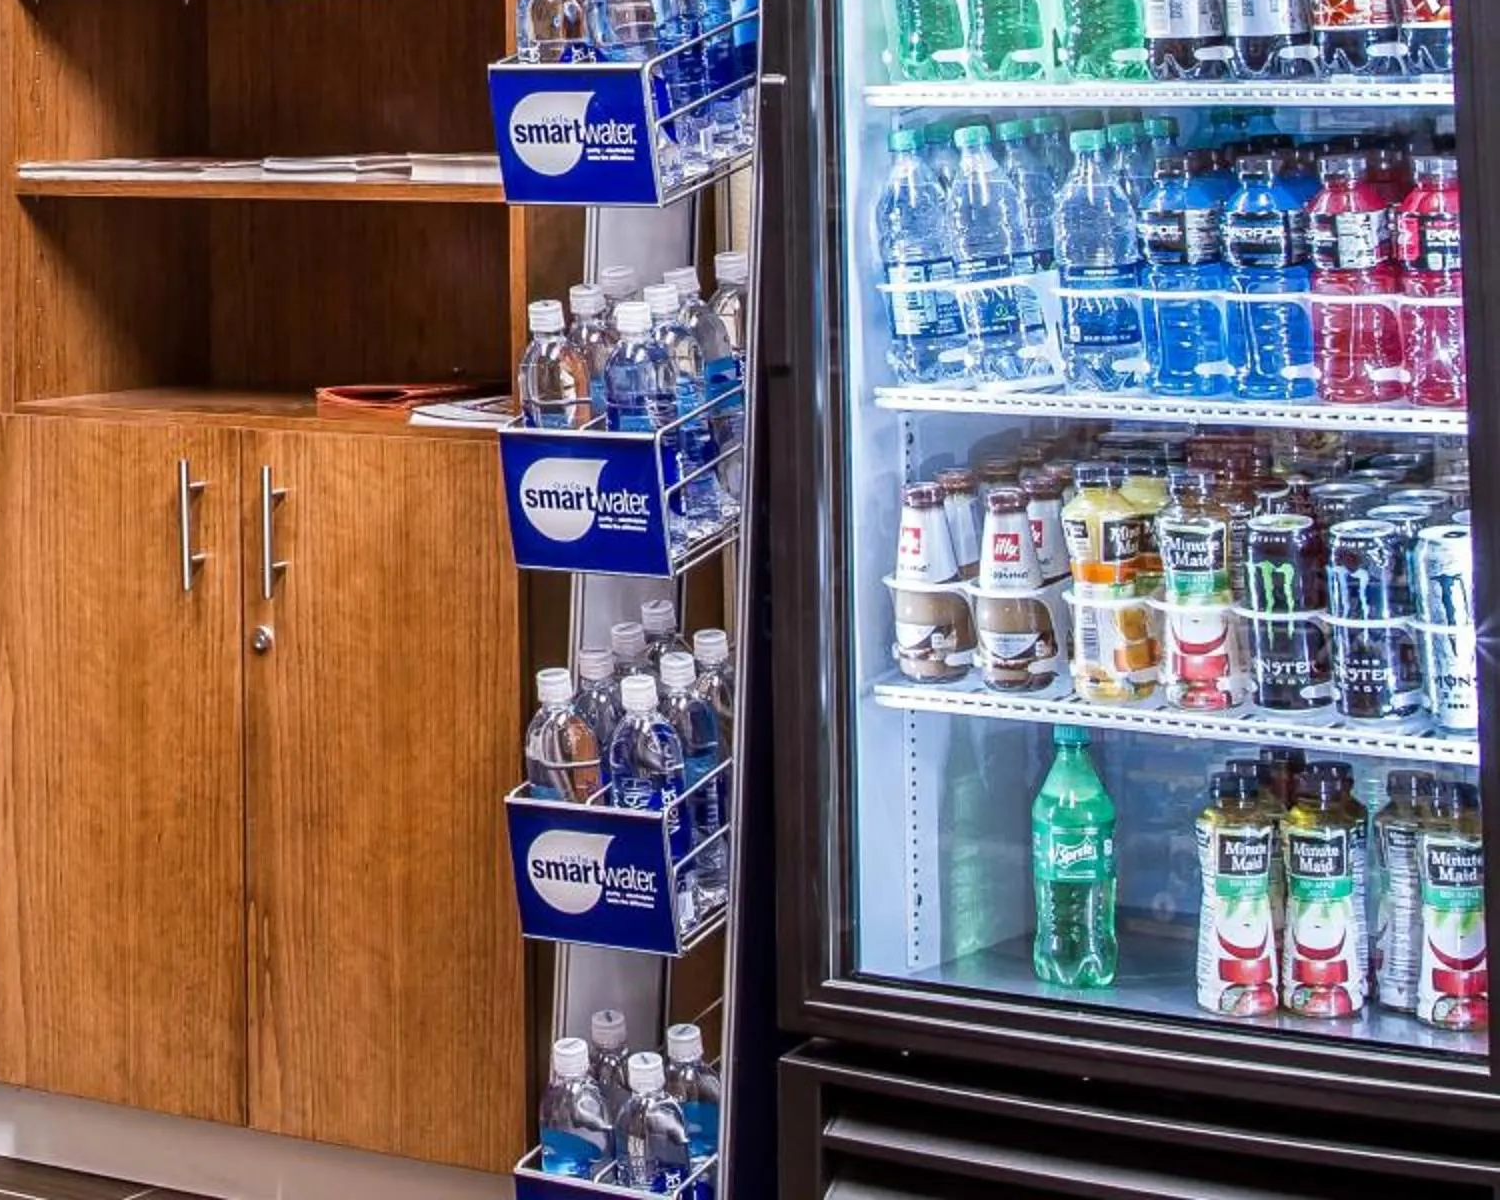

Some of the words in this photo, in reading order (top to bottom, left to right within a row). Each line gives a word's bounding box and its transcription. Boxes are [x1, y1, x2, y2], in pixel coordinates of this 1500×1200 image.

[994, 536, 1019, 561] illy
[1172, 551, 1215, 567] Maid
[1057, 843, 1095, 867] Sprite
[1293, 842, 1340, 857] Minute
[1231, 855, 1263, 871] Maid
[1300, 858, 1334, 873] Maid
[1439, 866, 1477, 881] Maid
